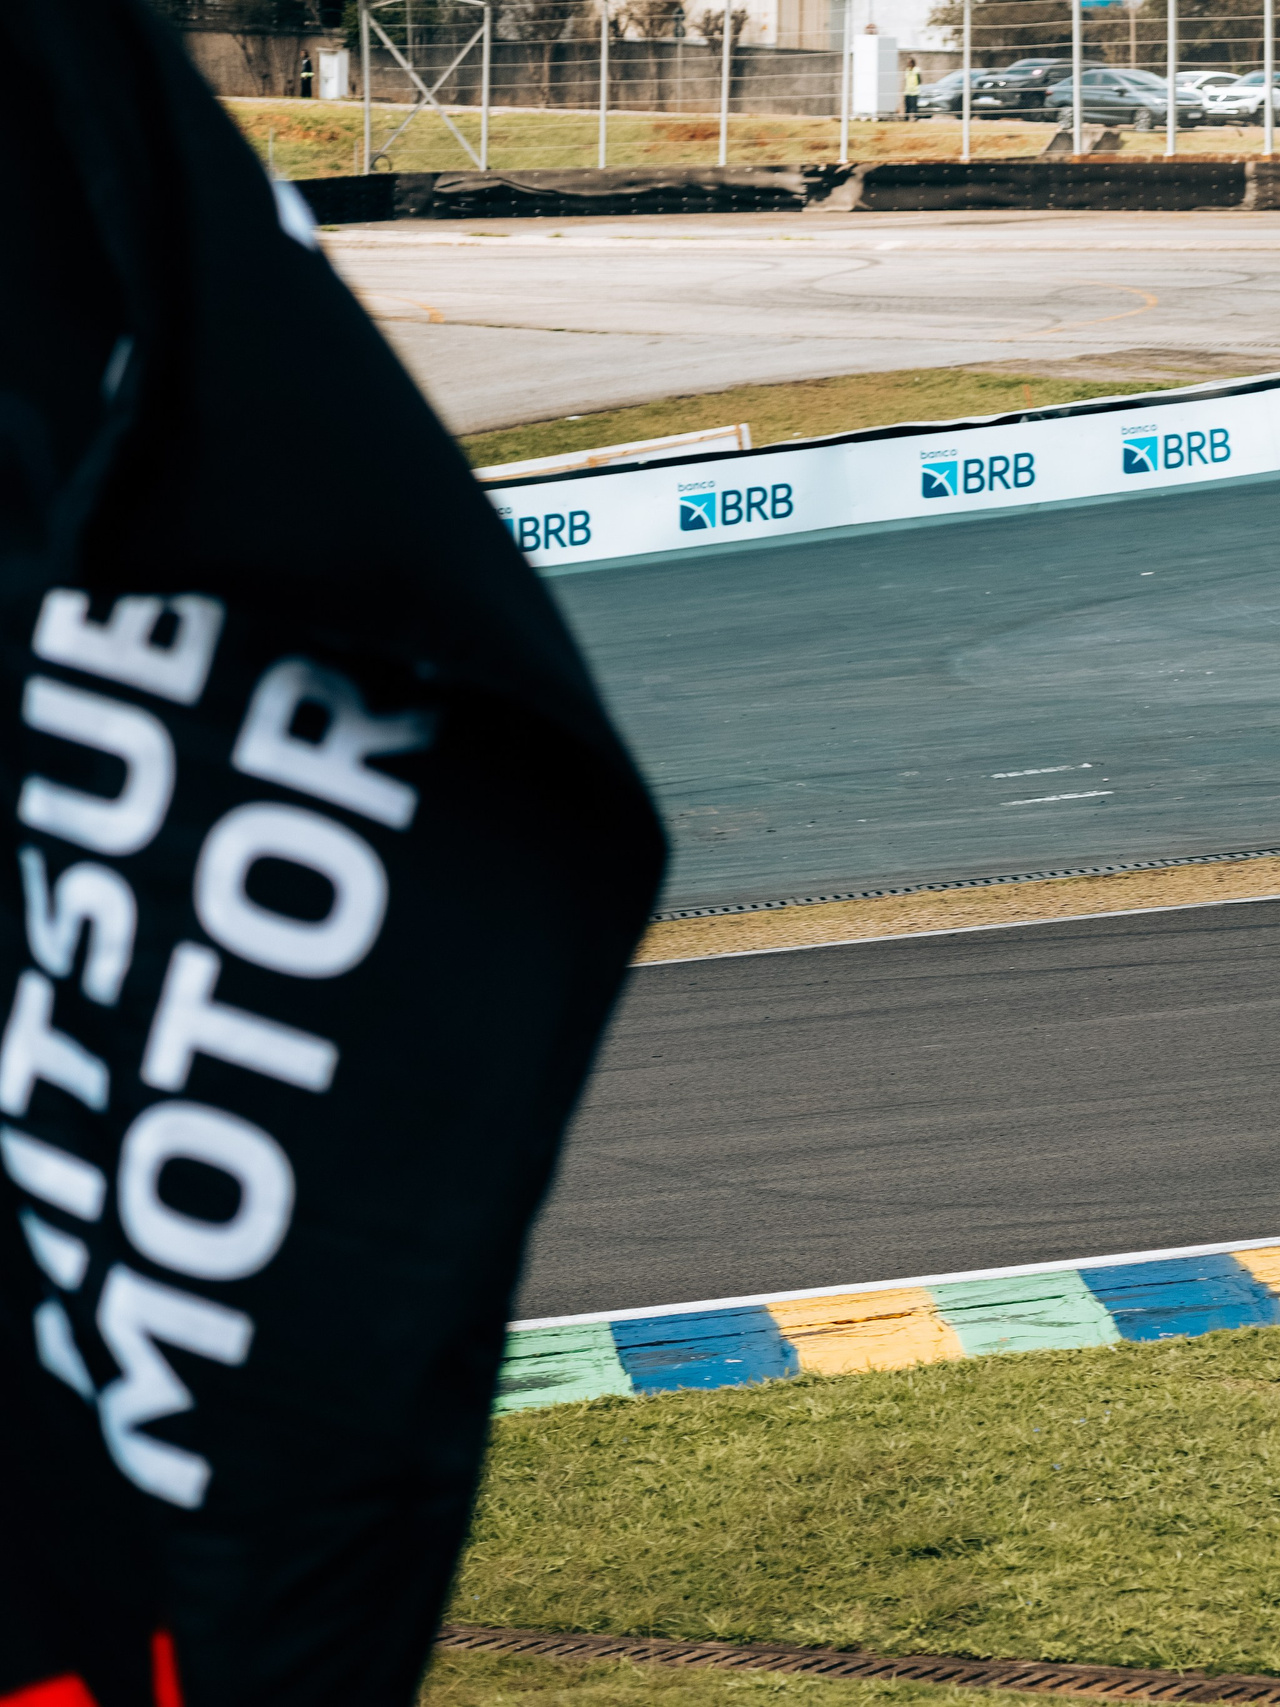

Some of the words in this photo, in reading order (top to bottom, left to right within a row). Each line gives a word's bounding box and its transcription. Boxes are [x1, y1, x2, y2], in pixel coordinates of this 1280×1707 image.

[1121, 423, 1158, 435] banco
[1163, 428, 1231, 470] BRB
[920, 448, 958, 460] banco
[963, 452, 1036, 494] BRB
[677, 480, 716, 492] banco
[721, 483, 794, 526] BRB
[519, 510, 592, 553] BRB
